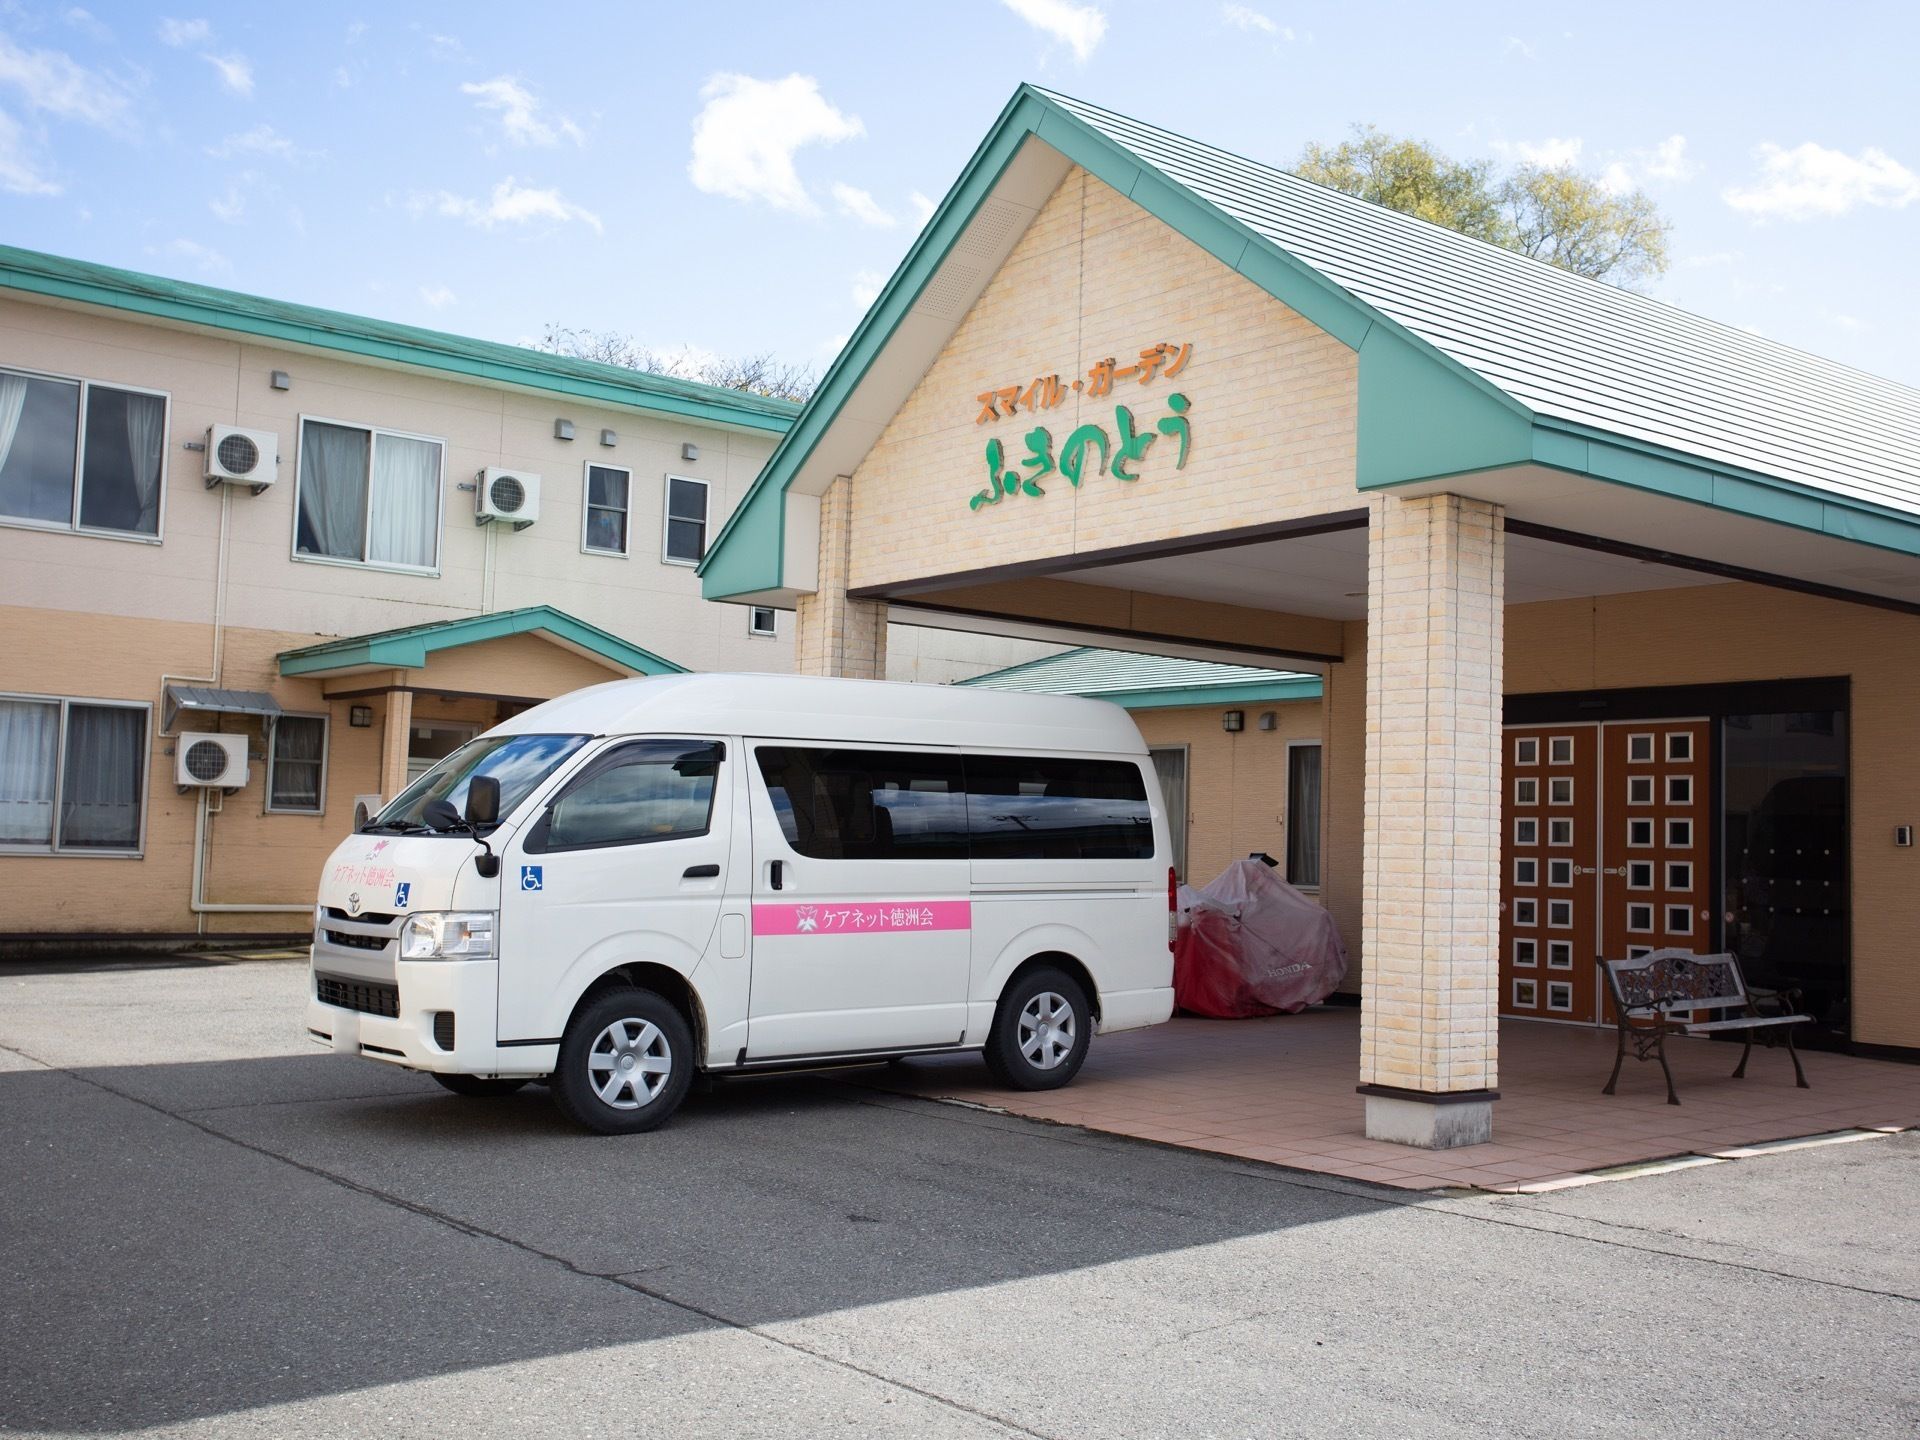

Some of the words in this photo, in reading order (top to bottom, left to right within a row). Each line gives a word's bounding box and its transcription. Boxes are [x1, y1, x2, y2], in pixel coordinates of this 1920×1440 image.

[976, 343, 1193, 425] スマイル・ガーデン
[970, 392, 1191, 511] ふきのとう
[822, 907, 934, 929] ケアネット徳洲会
[1267, 960, 1312, 977] HONDA
